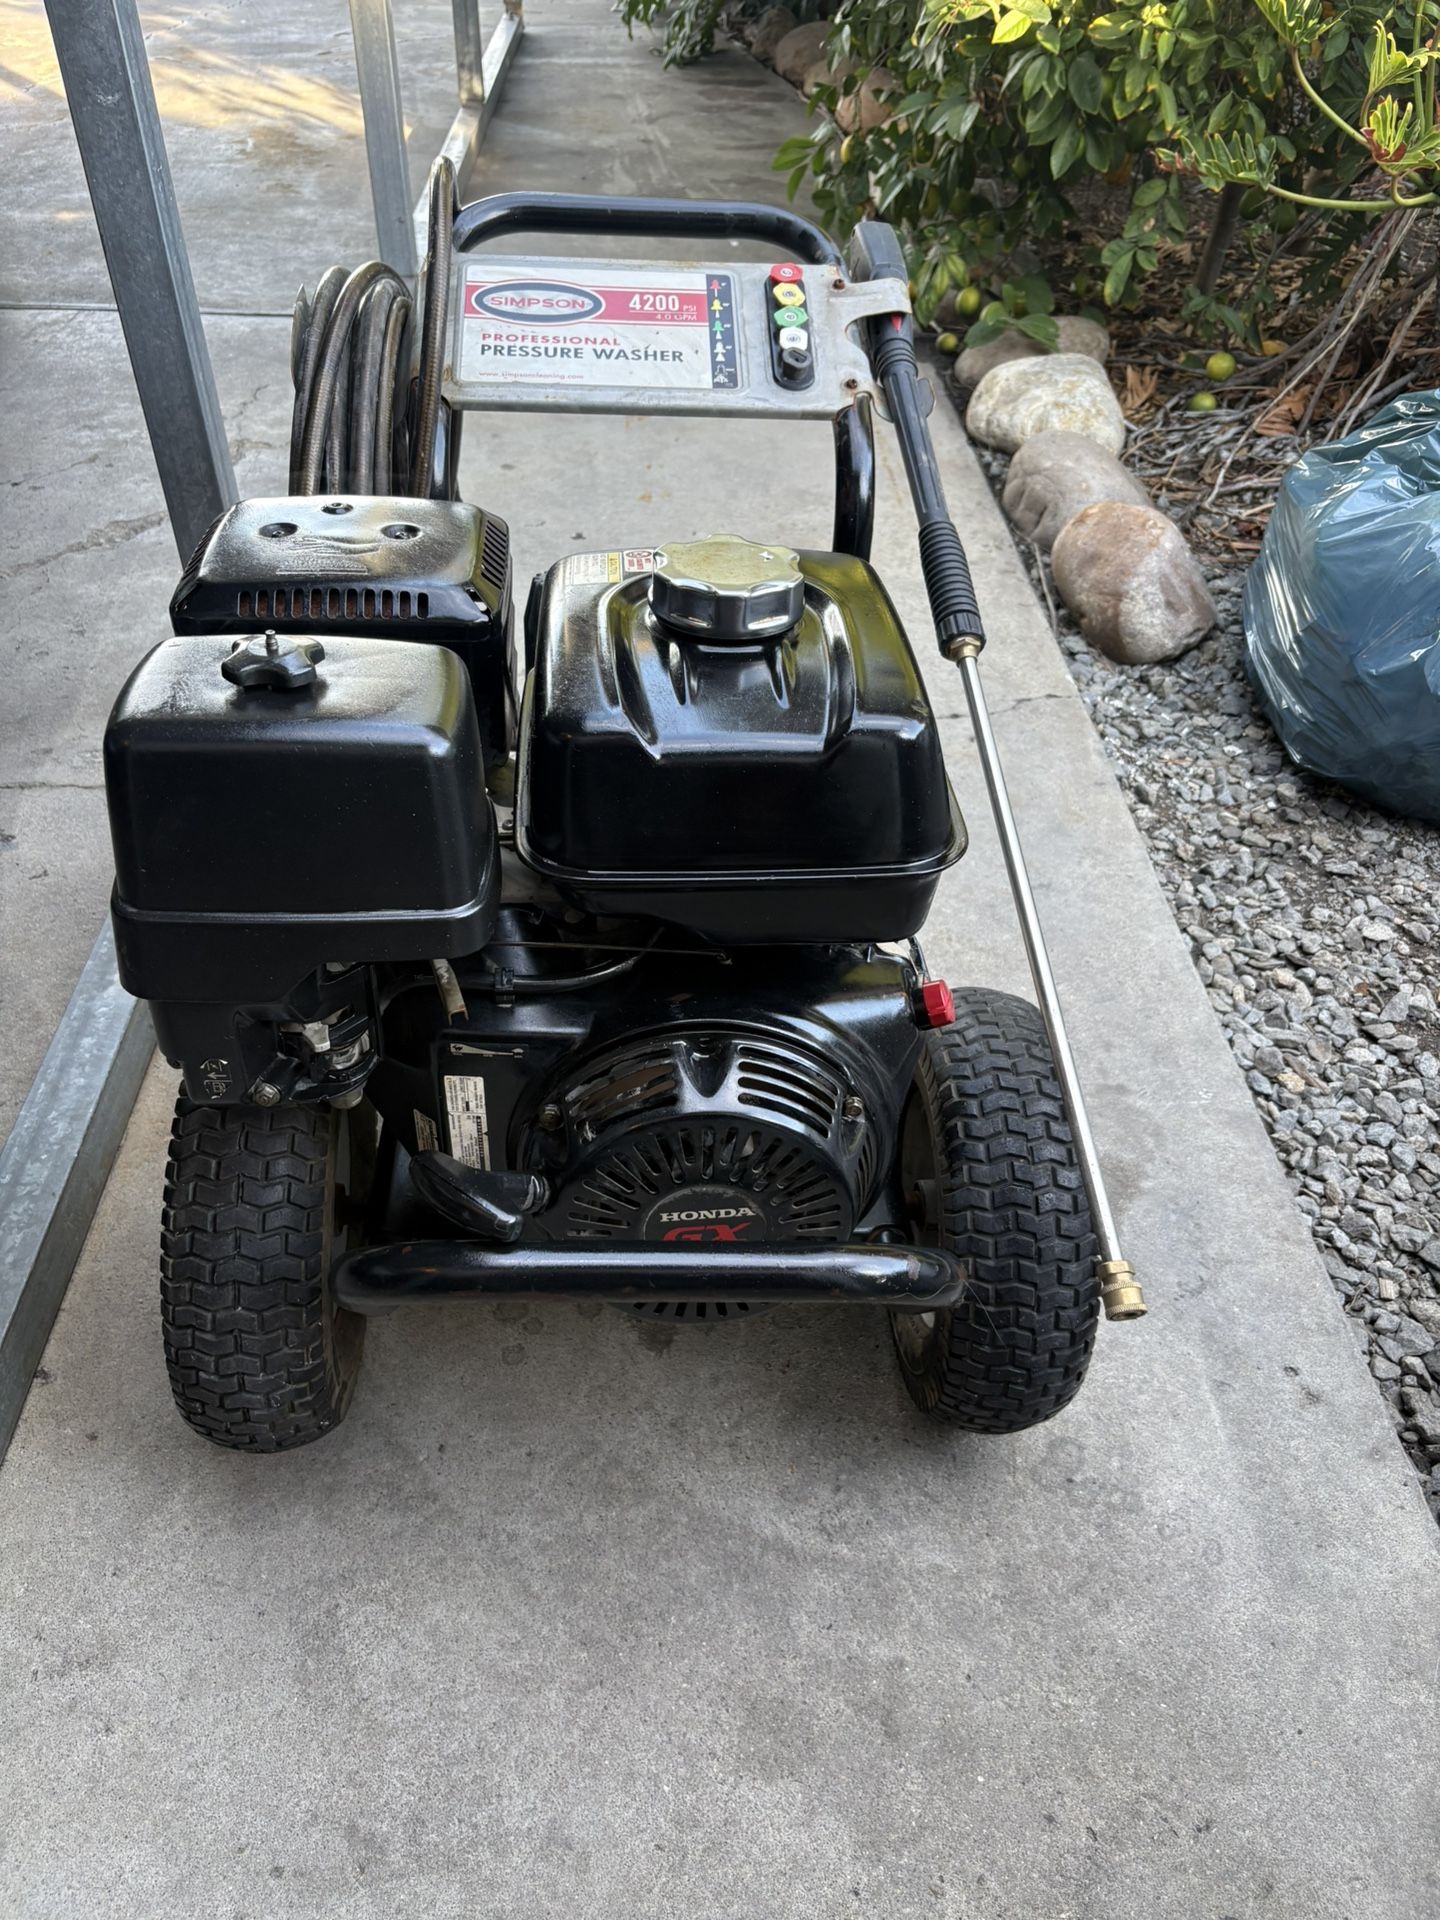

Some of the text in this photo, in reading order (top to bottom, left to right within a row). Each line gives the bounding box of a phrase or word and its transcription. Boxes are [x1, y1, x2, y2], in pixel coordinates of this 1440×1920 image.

[489, 296, 586, 309] SIMPSON
[629, 293, 679, 311] 4200
[482, 333, 621, 346] PROFESSIONAL
[480, 344, 684, 362] PRESSURE WASHER
[660, 1207, 756, 1222] HONDA
